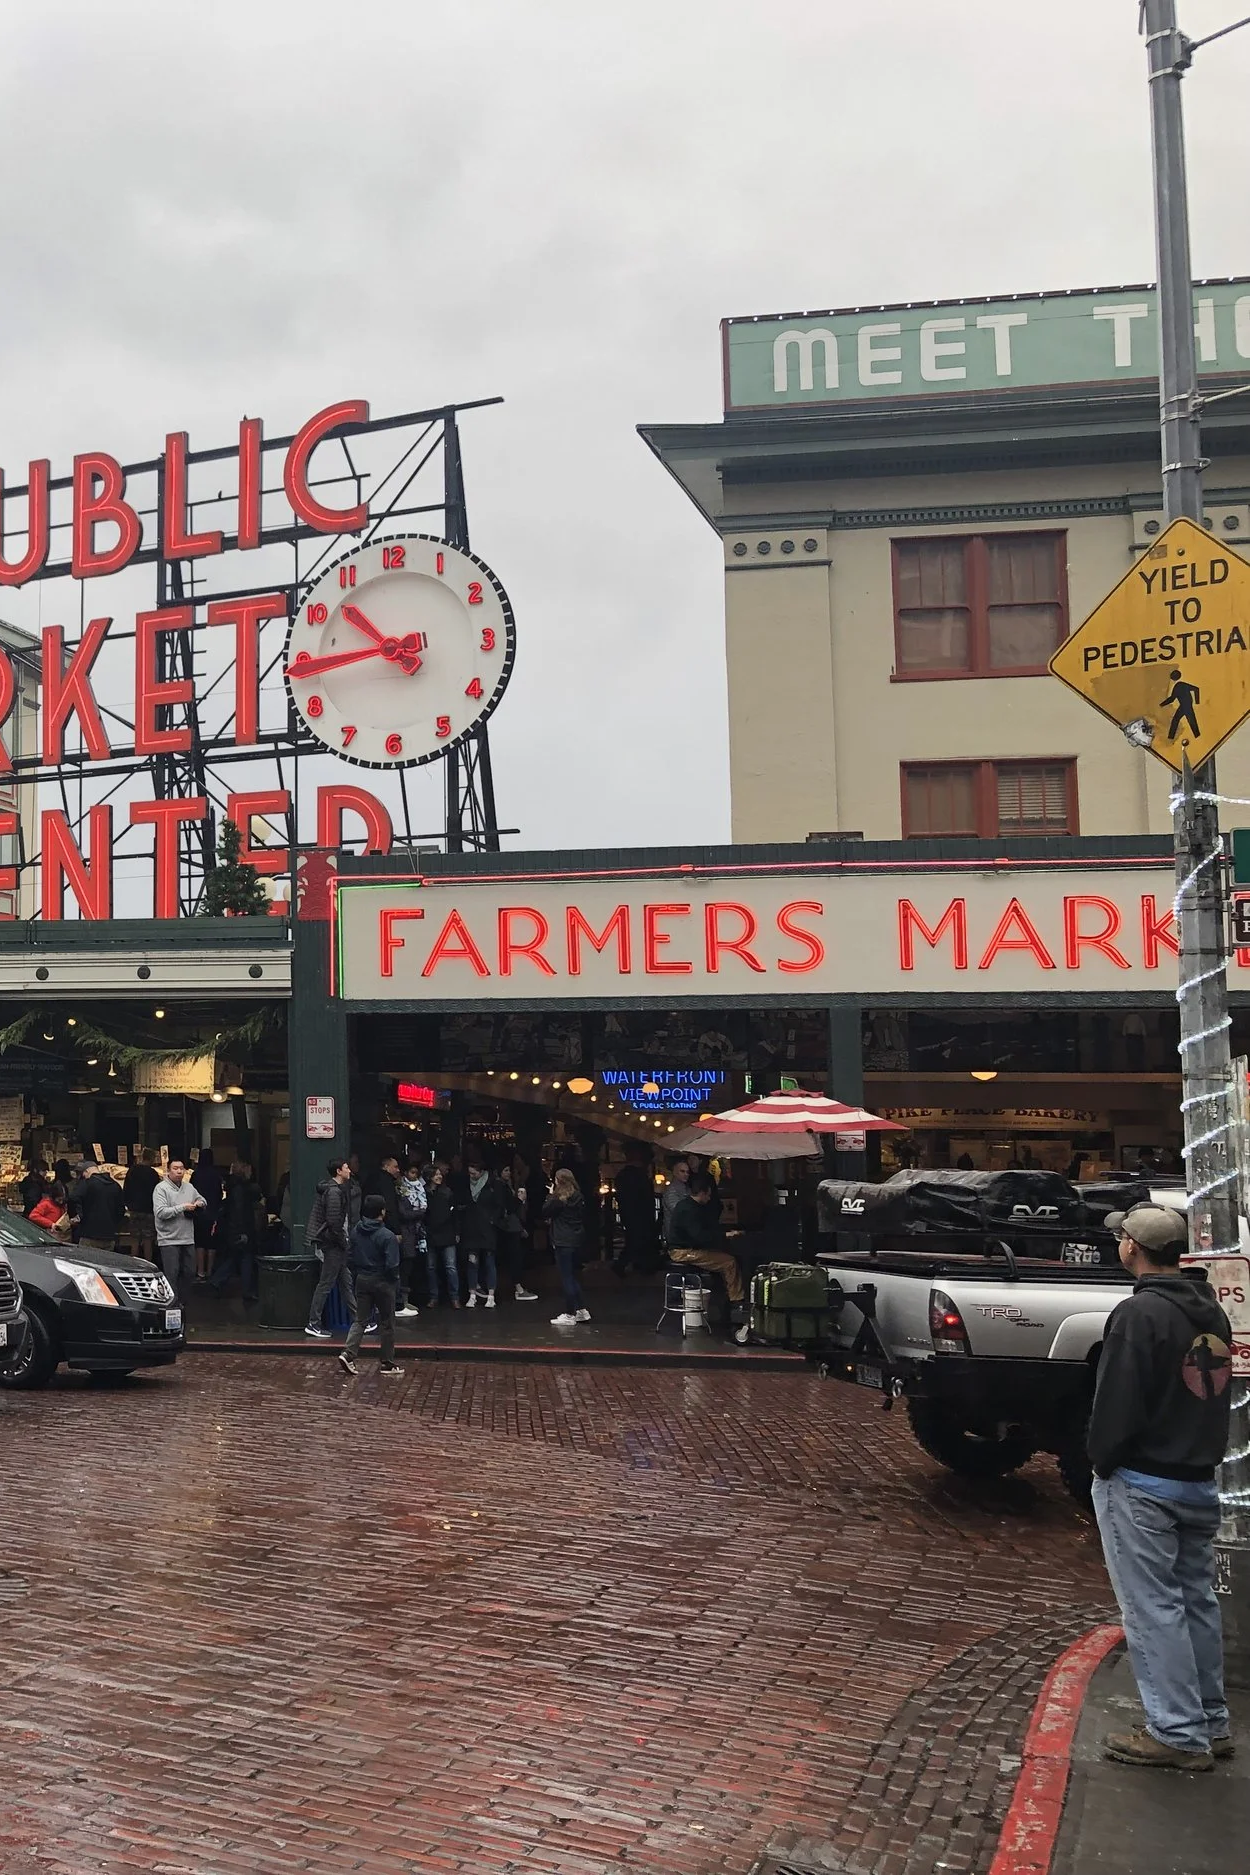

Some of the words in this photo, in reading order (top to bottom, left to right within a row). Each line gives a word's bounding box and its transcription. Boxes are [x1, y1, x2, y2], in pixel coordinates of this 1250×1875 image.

[773, 313, 1028, 392] MEET
[383, 546, 405, 569] 12
[436, 552, 444, 574] 1
[340, 565, 357, 588] 11
[1139, 558, 1229, 594] YIELD
[468, 582, 483, 605] 2
[307, 603, 327, 625] 10
[1165, 597, 1201, 625] TO
[481, 628, 495, 651] 3
[1084, 626, 1250, 672] PEDESTRIA
[465, 677, 483, 699] 4
[307, 696, 323, 717] 8
[341, 726, 357, 748] 7
[436, 716, 451, 738] 5
[385, 734, 402, 756] 6
[378, 901, 824, 978] FARMERS
[898, 891, 1250, 972] MARK
[619, 1088, 711, 1101] VIEWPOINT
[976, 1307, 1022, 1319] TRD
